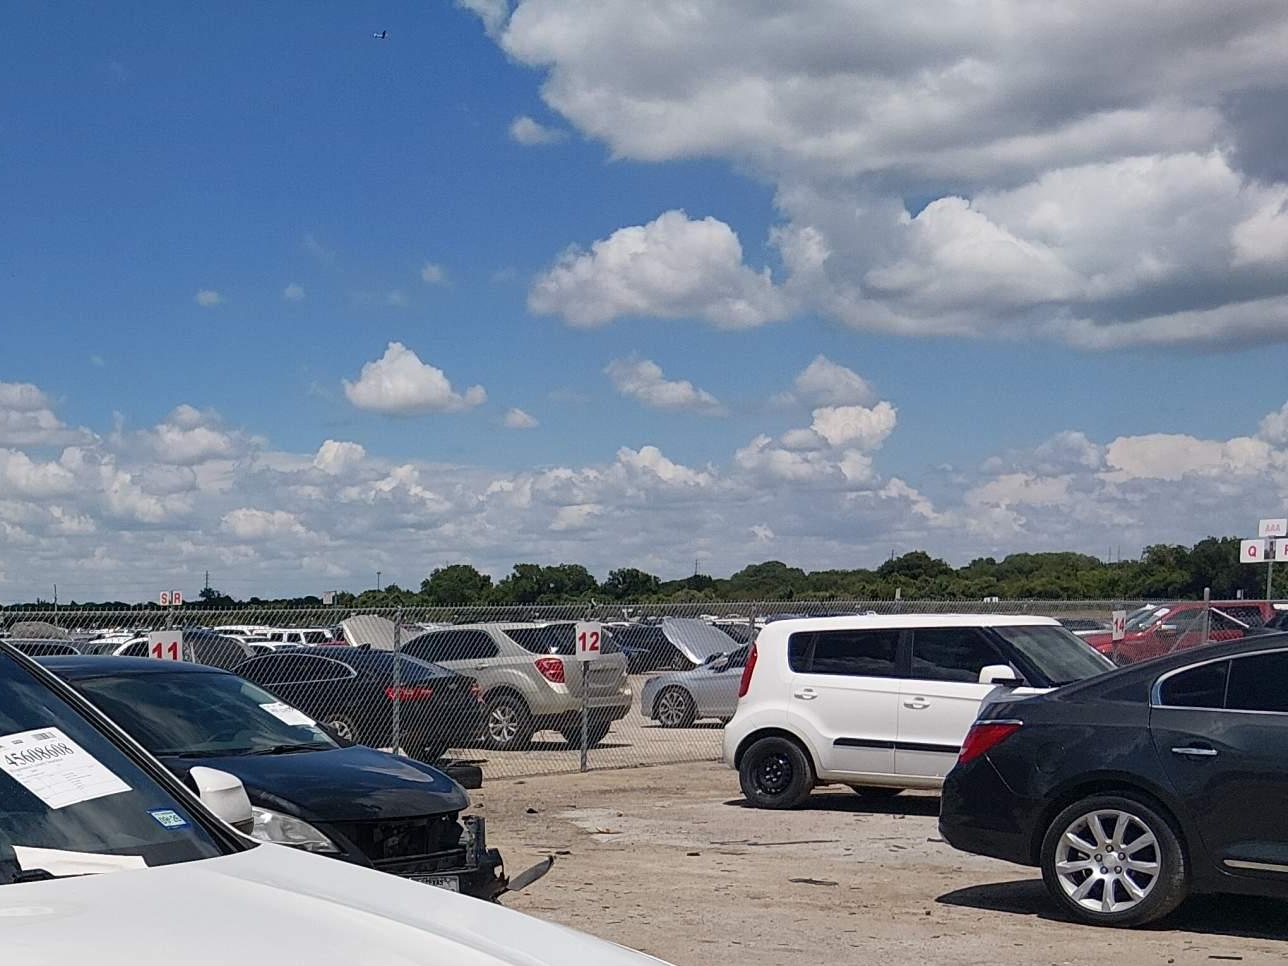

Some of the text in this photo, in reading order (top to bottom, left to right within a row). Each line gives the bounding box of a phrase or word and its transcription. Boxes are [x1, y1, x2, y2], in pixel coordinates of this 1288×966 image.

[1247, 545, 1257, 558] Q
[160, 592, 168, 604] S
[173, 592, 181, 604] R
[1114, 617, 1125, 632] 14
[578, 631, 599, 652] 12
[152, 641, 178, 661] 11
[4, 743, 75, 767] 45608608
